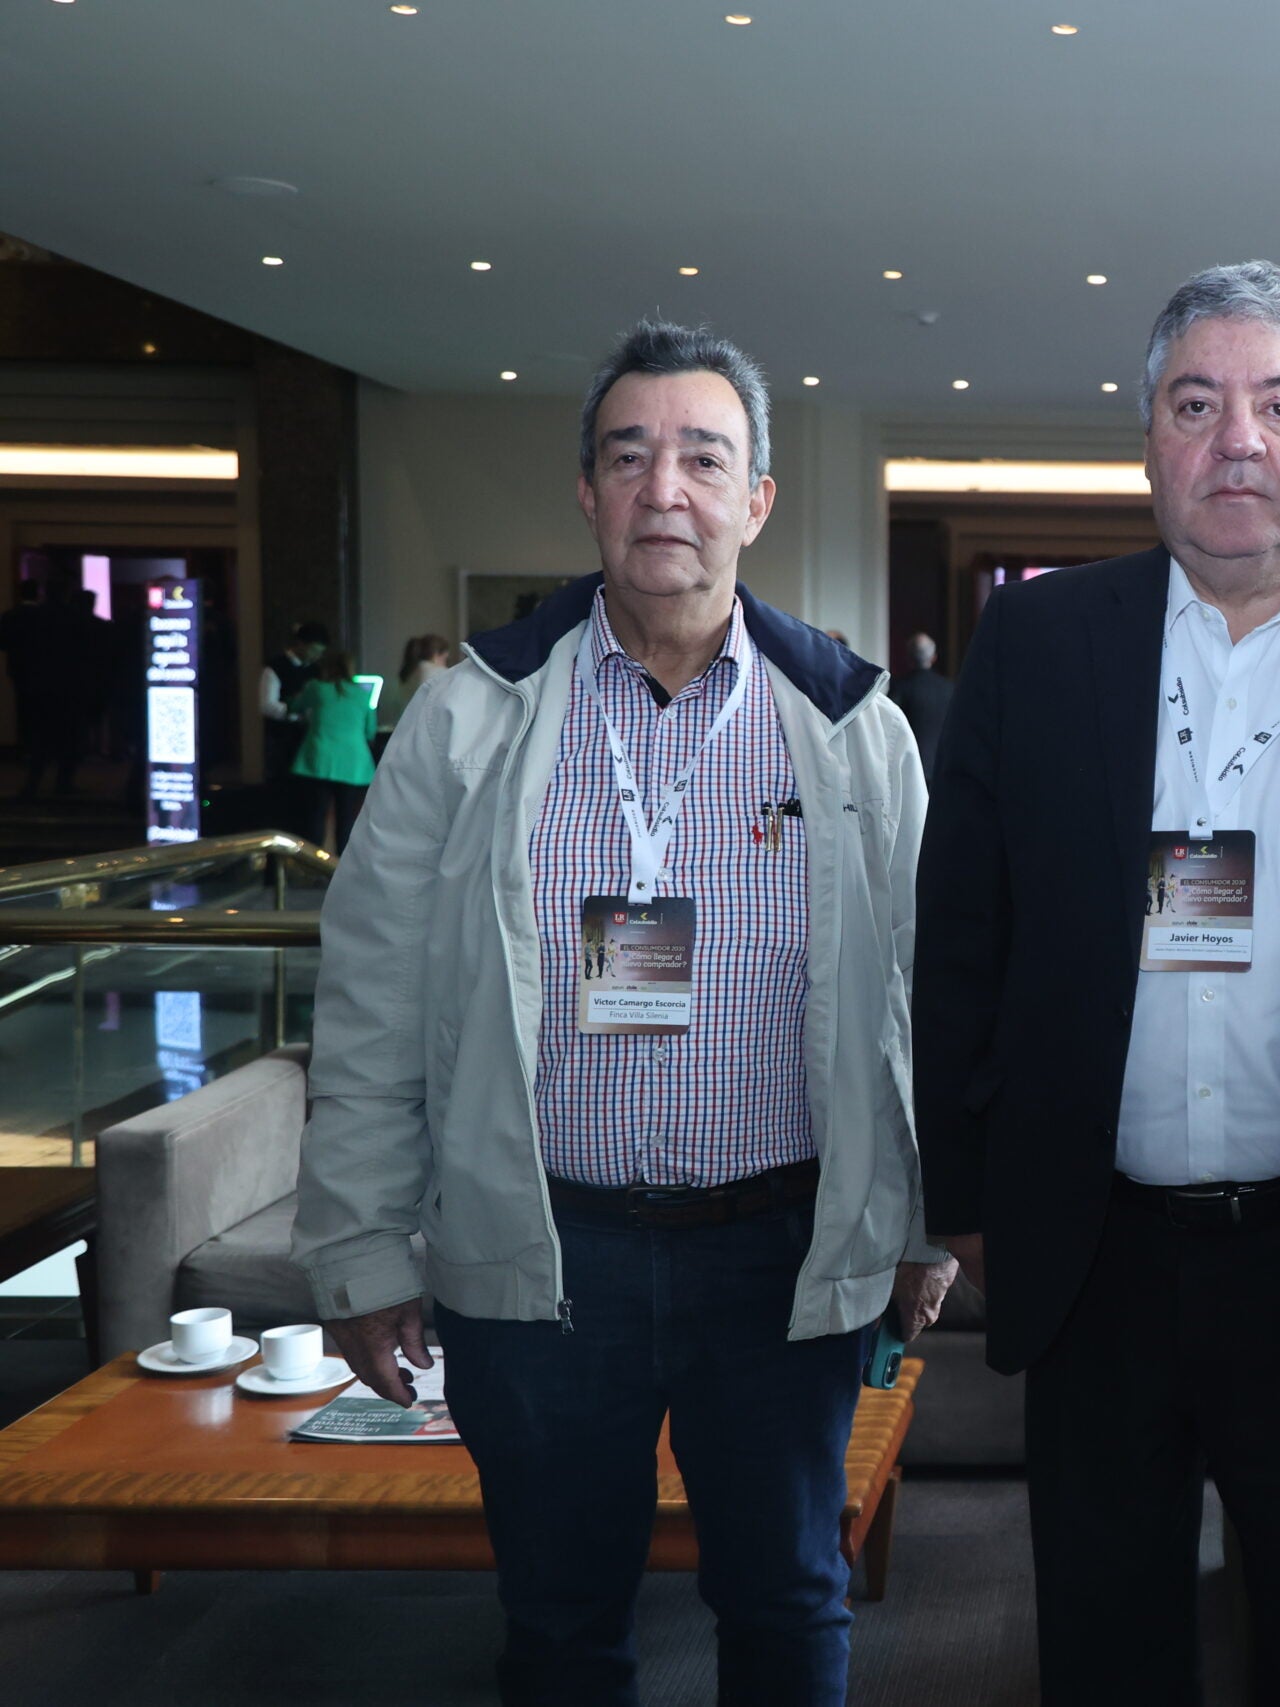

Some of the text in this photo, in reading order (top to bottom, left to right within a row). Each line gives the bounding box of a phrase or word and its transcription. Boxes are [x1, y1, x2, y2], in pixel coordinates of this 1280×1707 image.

[1176, 676, 1190, 716] Colsubsidio
[1217, 746, 1246, 782] Colsubsidio
[1213, 887, 1235, 896] llegar
[1203, 895, 1248, 904] comprador?
[1169, 933, 1233, 945] Javier Hoyos
[653, 952, 674, 962] llegar
[675, 953, 682, 961] al
[643, 960, 688, 969] comprador?
[618, 998, 654, 1008] Camargo
[655, 999, 686, 1008] Escorcia
[609, 1011, 628, 1019] Finca
[629, 1011, 644, 1019] Villa
